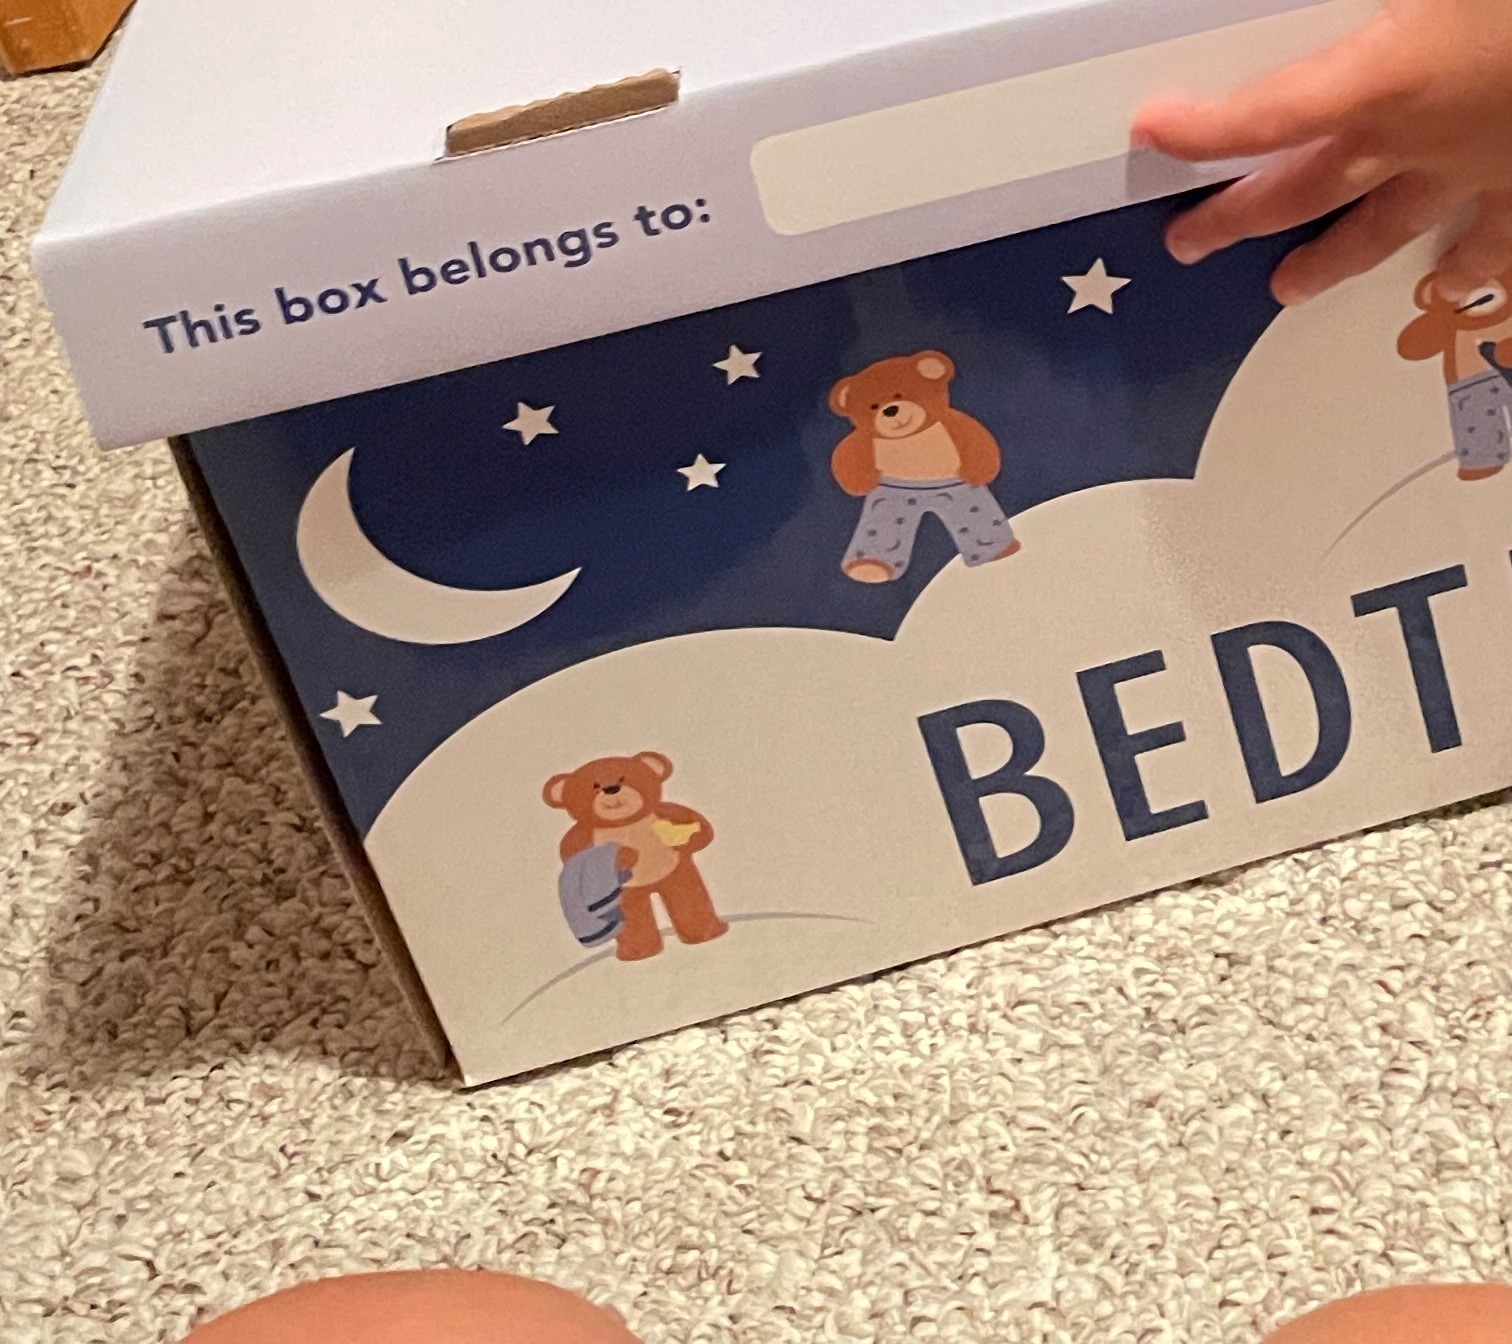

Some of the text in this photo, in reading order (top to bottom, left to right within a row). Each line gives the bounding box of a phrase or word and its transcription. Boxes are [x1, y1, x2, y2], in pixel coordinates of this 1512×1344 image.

[143, 197, 712, 355] This box belongs to:
